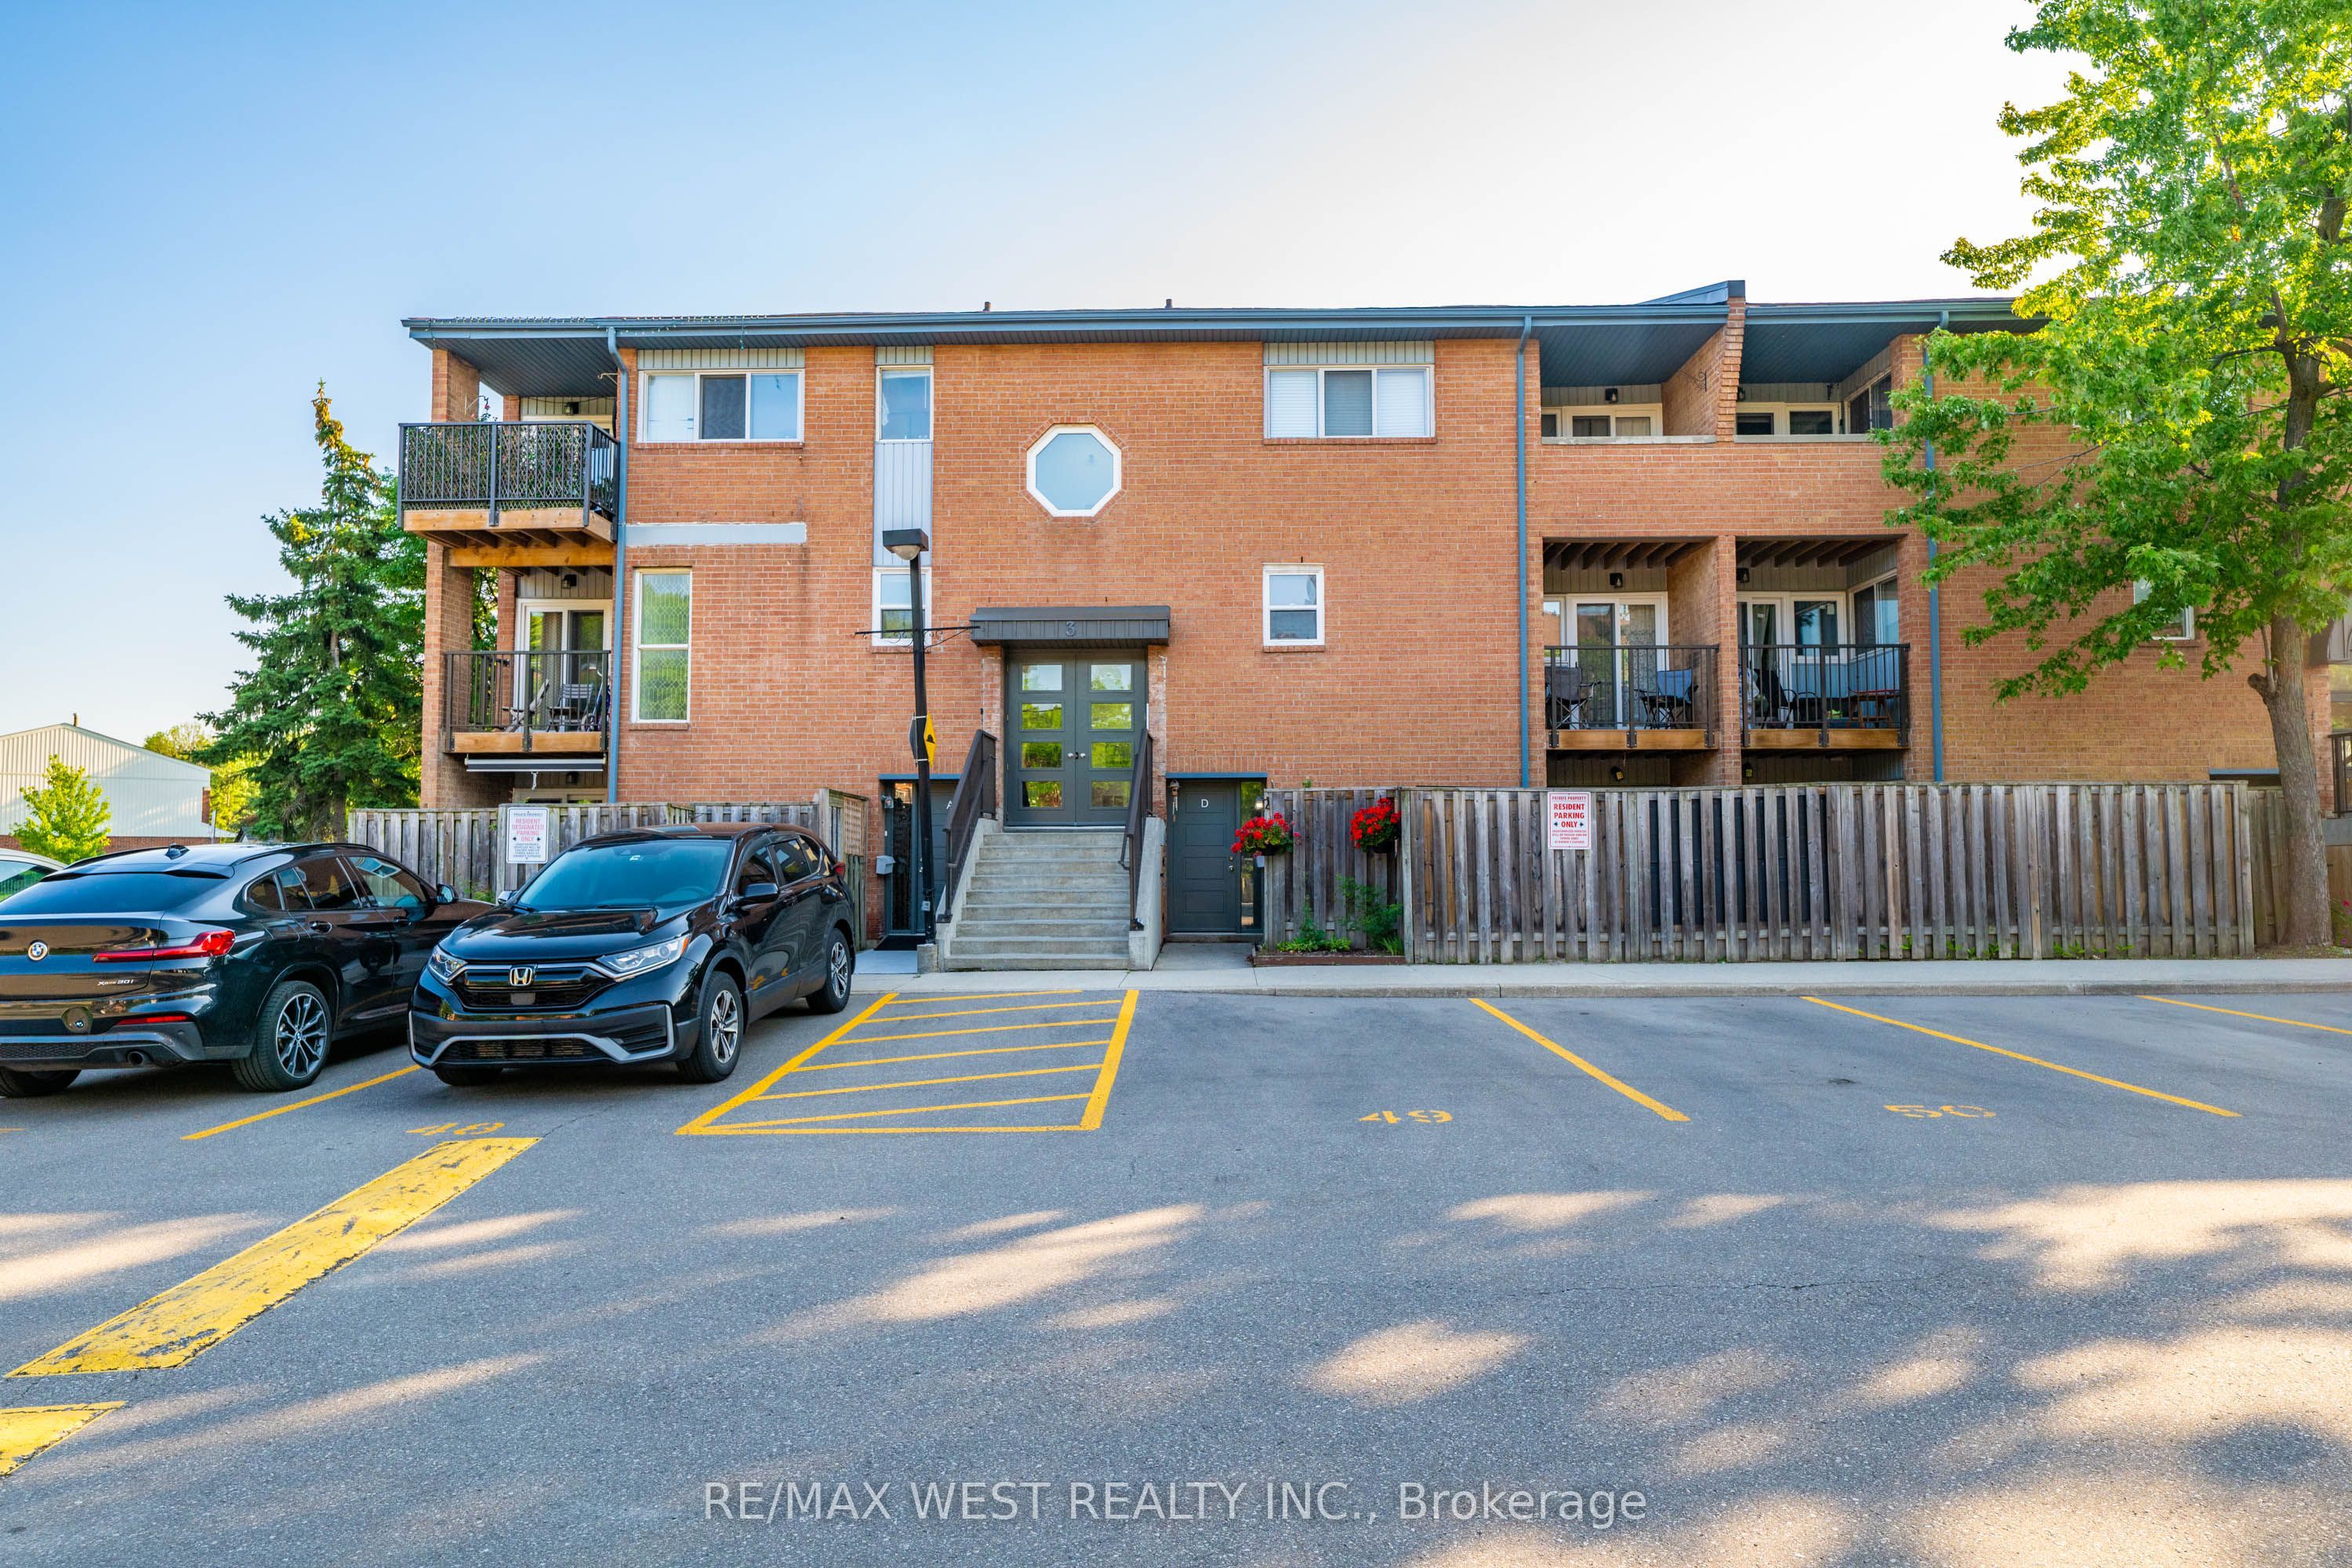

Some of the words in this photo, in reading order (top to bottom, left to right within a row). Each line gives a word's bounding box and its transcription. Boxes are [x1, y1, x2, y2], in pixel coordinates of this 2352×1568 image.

[1066, 620, 1075, 636] 3
[1201, 799, 1209, 808] D
[1358, 1109, 1454, 1124] 49
[1882, 1105, 1997, 1119] 50
